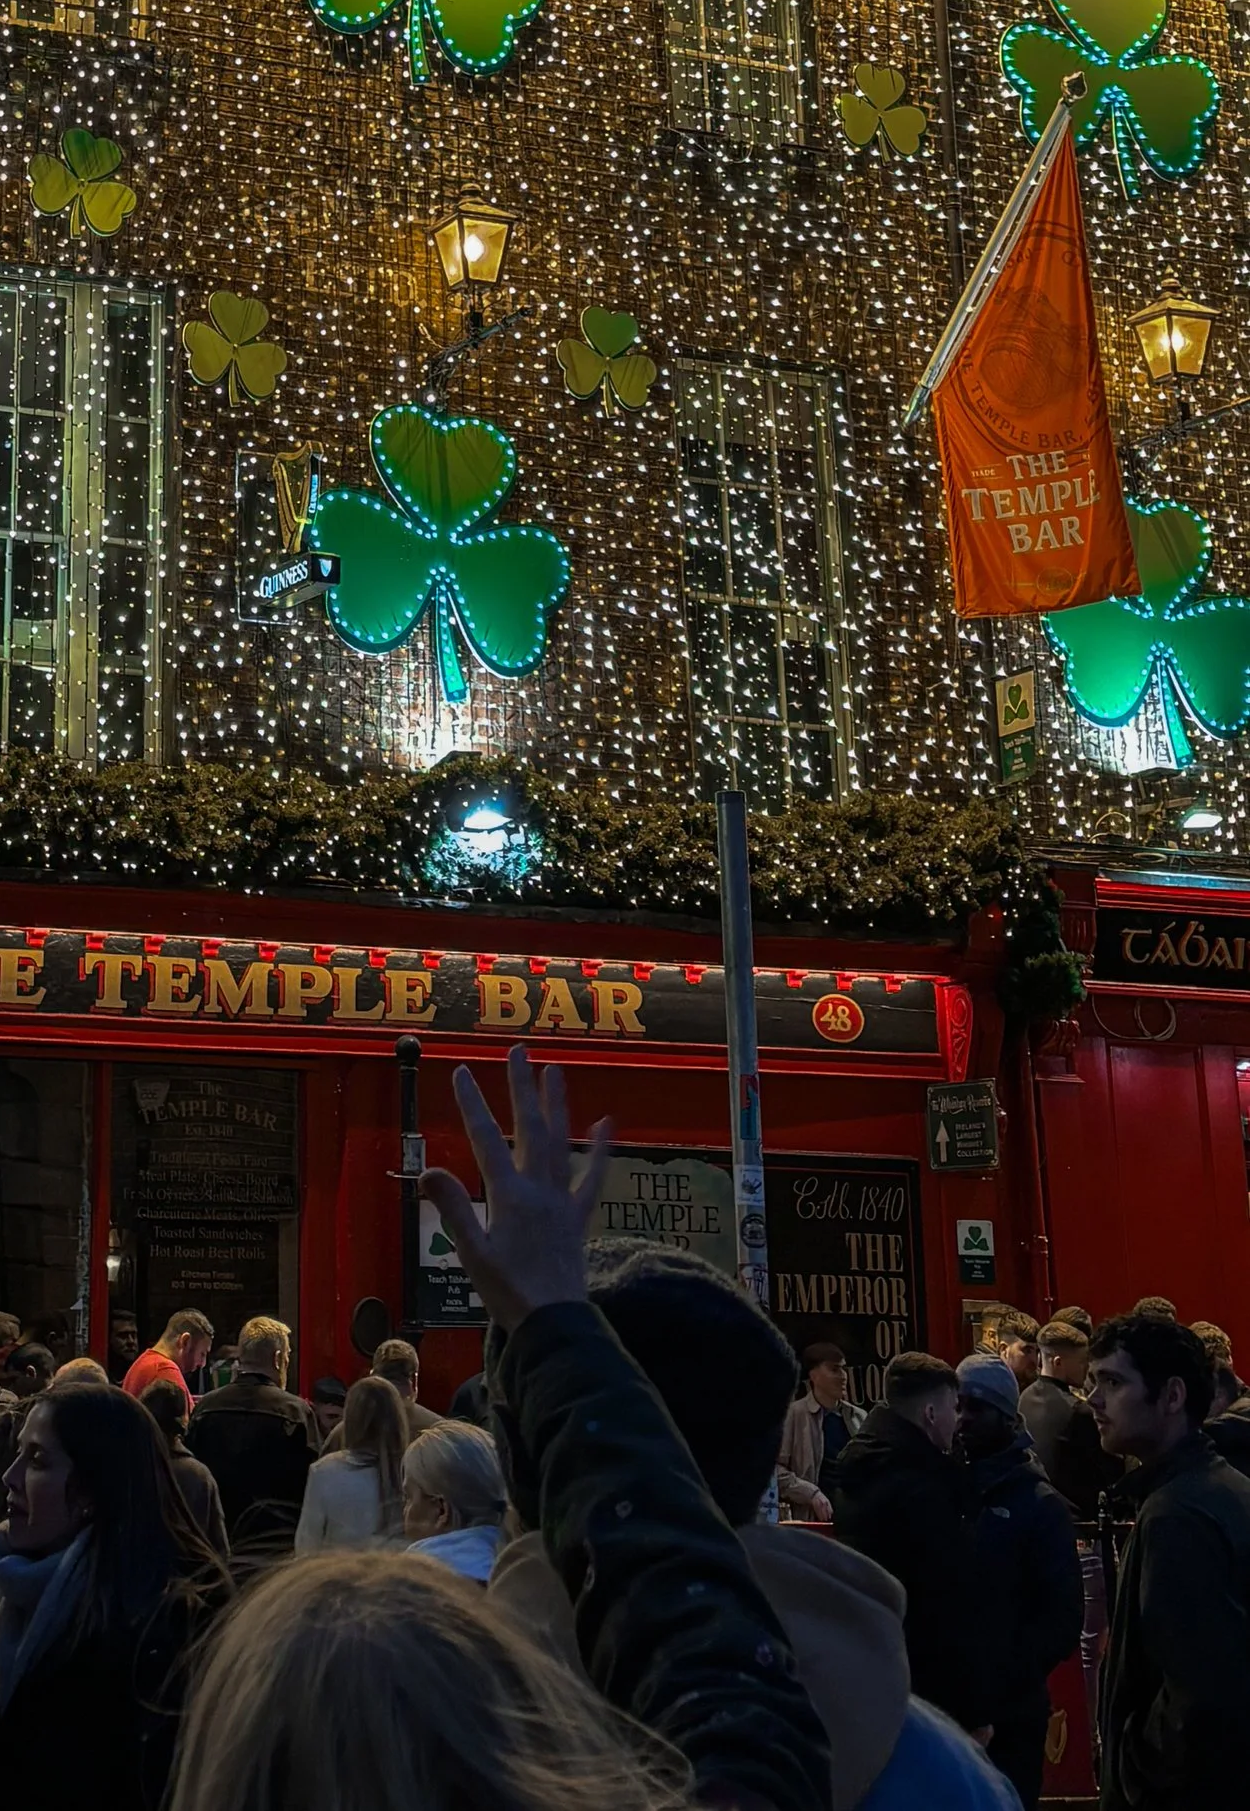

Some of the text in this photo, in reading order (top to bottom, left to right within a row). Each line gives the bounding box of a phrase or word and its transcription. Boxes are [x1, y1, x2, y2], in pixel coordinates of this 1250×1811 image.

[971, 381, 1031, 446] TEMPLE
[1006, 450, 1070, 480] THE
[961, 470, 1100, 522] TEMPLE
[1007, 516, 1085, 554] BAR
[260, 561, 309, 599] GUINNESS
[80, 951, 438, 1026] TEMPLE
[475, 972, 646, 1038] BAR
[820, 1002, 852, 1032] 48
[138, 1099, 279, 1133] TEMPLE BAR
[630, 1172, 693, 1203] THE
[857, 1185, 906, 1223] 1840
[153, 1225, 264, 1241] Toasted Sandwiches
[600, 1202, 721, 1235] TEMPLE
[149, 1244, 267, 1261] Hot Roast Beef Rolls
[844, 1232, 904, 1273] THE
[774, 1272, 910, 1318] EMPEROR
[874, 1319, 910, 1360] OF
